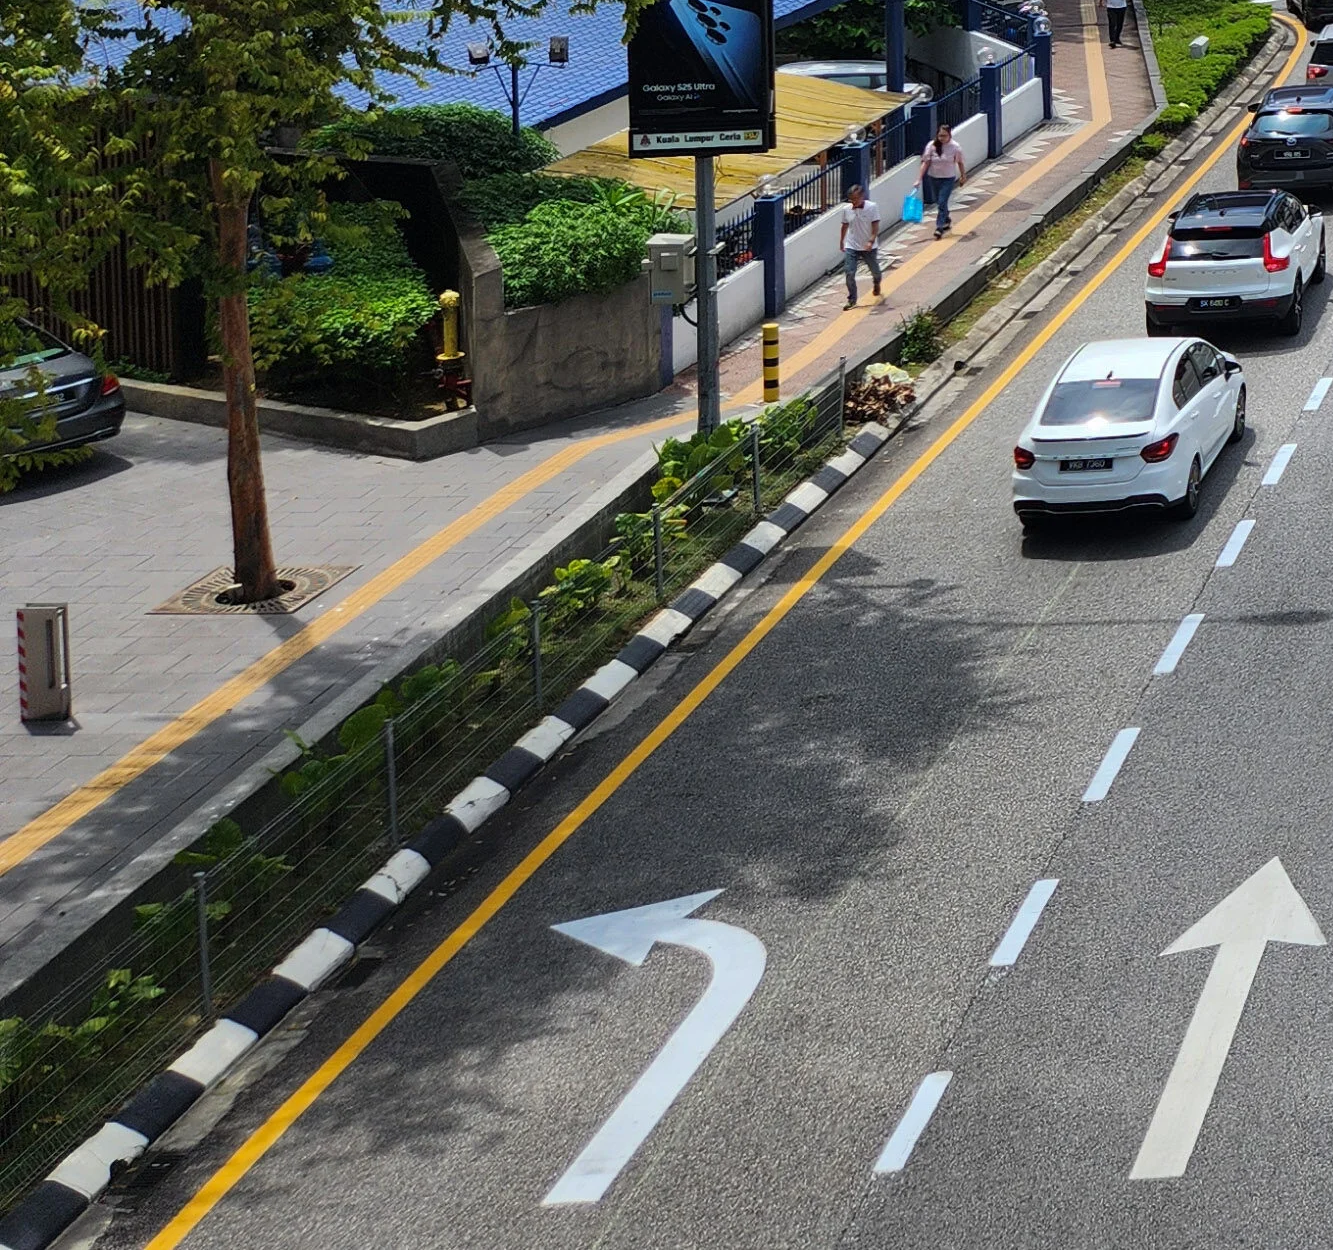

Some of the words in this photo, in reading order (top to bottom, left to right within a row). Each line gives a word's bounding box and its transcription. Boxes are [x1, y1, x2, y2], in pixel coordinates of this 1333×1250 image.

[642, 84, 677, 93] Galaxy
[677, 83, 692, 91] S25
[693, 83, 715, 91] Ultra
[656, 94, 685, 102] Galaxy
[656, 135, 680, 144] Kuala
[684, 134, 715, 144] Lumpur
[719, 133, 741, 142] Ceria
